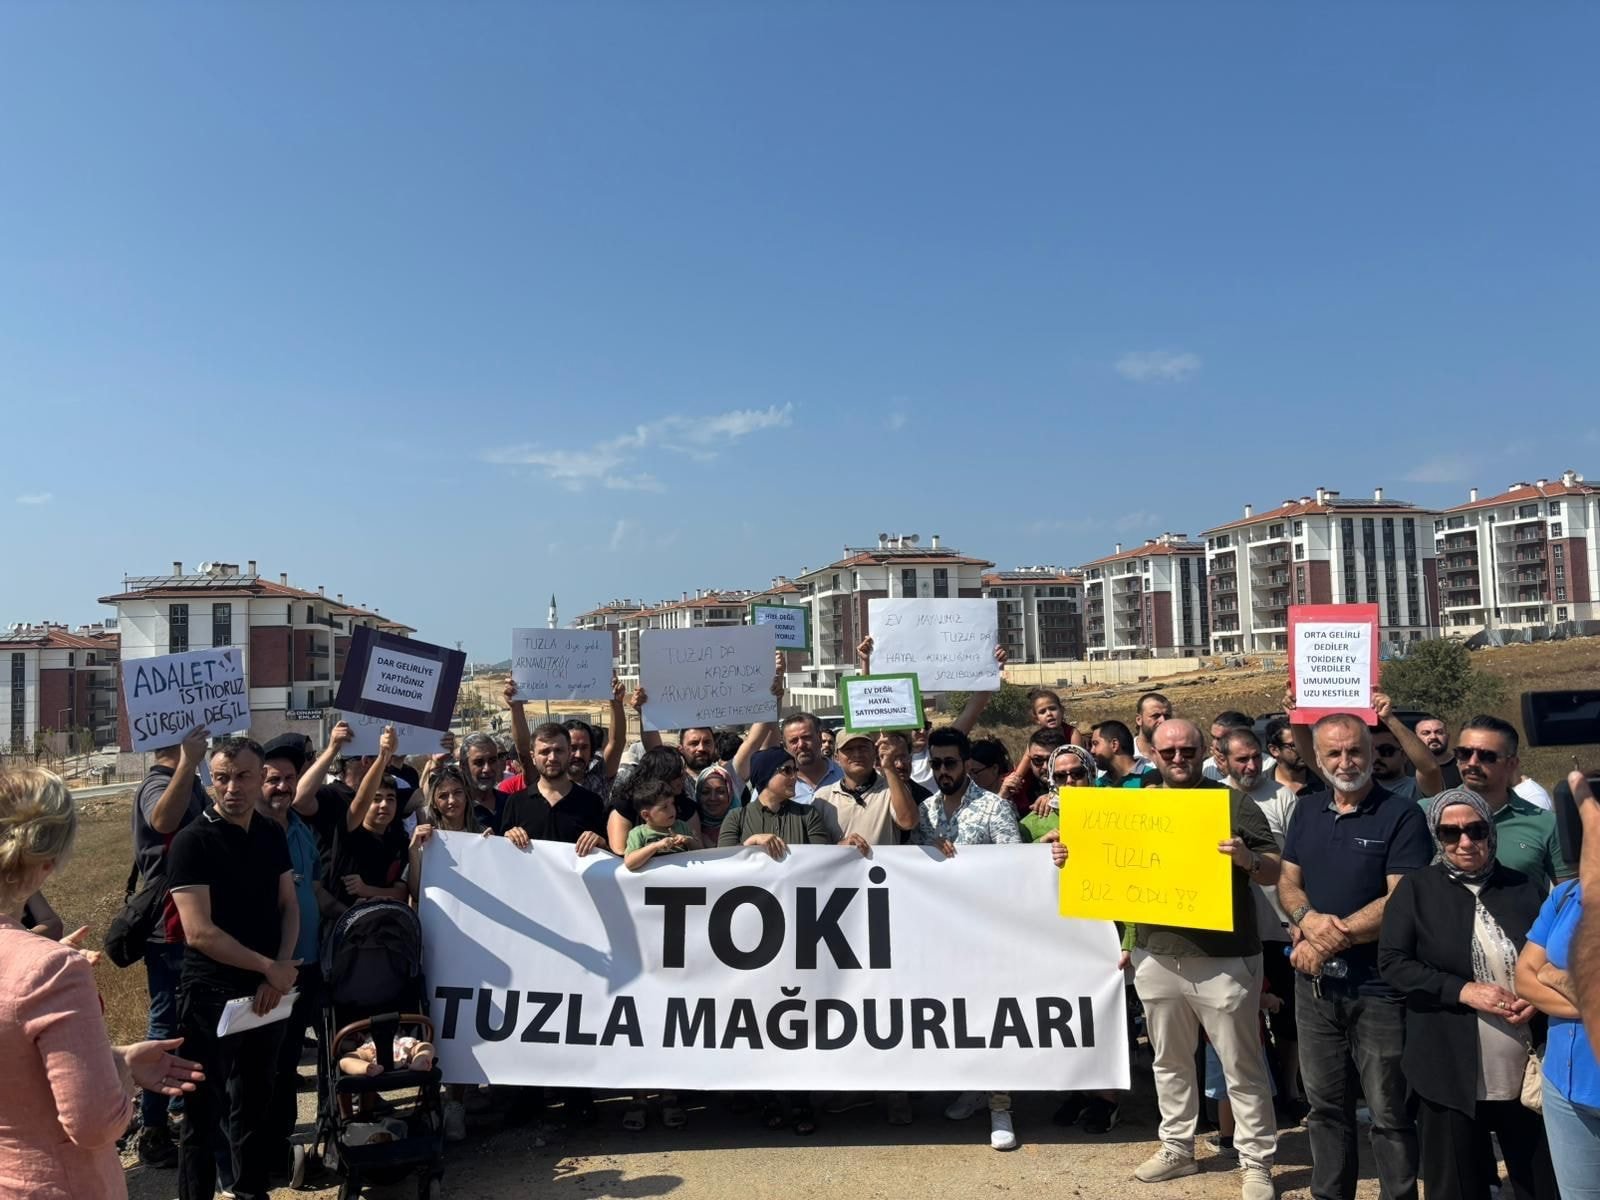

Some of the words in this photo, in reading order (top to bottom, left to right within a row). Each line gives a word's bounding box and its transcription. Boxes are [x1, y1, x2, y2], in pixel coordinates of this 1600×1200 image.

[885, 614, 902, 626] EV
[940, 632, 976, 643] TUZLA
[1304, 631, 1326, 639] ORTA
[1329, 630, 1361, 639] GELİRLİ
[522, 638, 557, 650] TUZLA
[1314, 642, 1349, 651] DEDİLER
[665, 646, 712, 664] TUZLA
[720, 645, 736, 659] DA
[886, 653, 917, 663] HAYAL
[1306, 655, 1343, 663] TOKİDEN
[377, 657, 395, 668] DAR
[396, 661, 435, 676] GELİRLİYE
[1311, 664, 1351, 672] VERDİLER
[381, 671, 425, 688] YAPTIĞINIZ
[1303, 677, 1360, 685] UMUMUDUM
[179, 678, 246, 705] İSTİYORUZ
[376, 684, 423, 701] ZÜLÜMDÜR
[741, 683, 756, 694] DE
[874, 685, 893, 694] DEĞİL
[1322, 689, 1360, 697] KESTİLER
[204, 700, 247, 725] DEĞİL
[856, 707, 907, 716] SATIYORSUNUZ
[1102, 842, 1161, 868] TUZLA
[1082, 880, 1114, 901] BUZ
[1126, 884, 1168, 904] OLDU
[644, 866, 892, 971] TOKİ
[434, 986, 645, 1048] TUZLA
[662, 986, 1096, 1051] MAĞDURLARI
